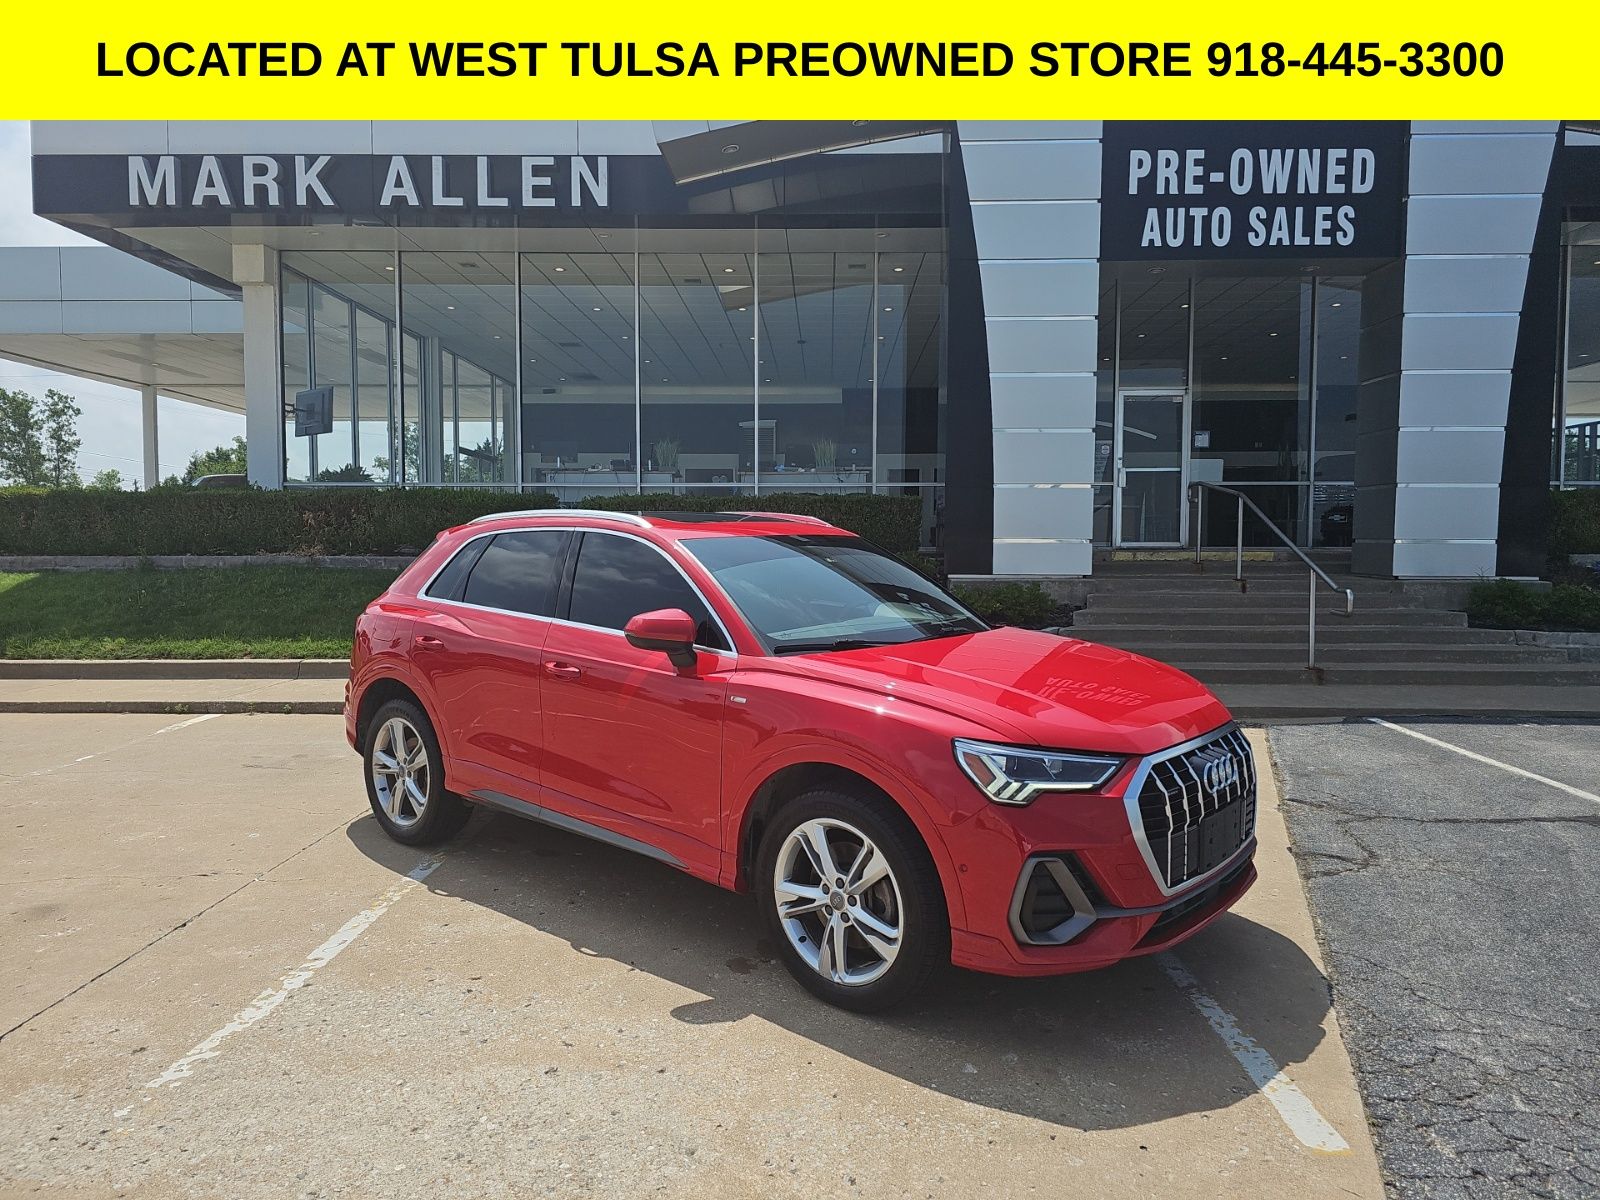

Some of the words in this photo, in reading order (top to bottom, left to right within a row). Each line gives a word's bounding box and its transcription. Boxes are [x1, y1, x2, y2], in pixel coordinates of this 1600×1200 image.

[128, 155, 335, 207] MARK
[380, 155, 609, 207] ALLEN
[1128, 148, 1376, 195] PRE-OWNED
[1141, 206, 1231, 248] AUTO
[1248, 205, 1355, 247] SALES
